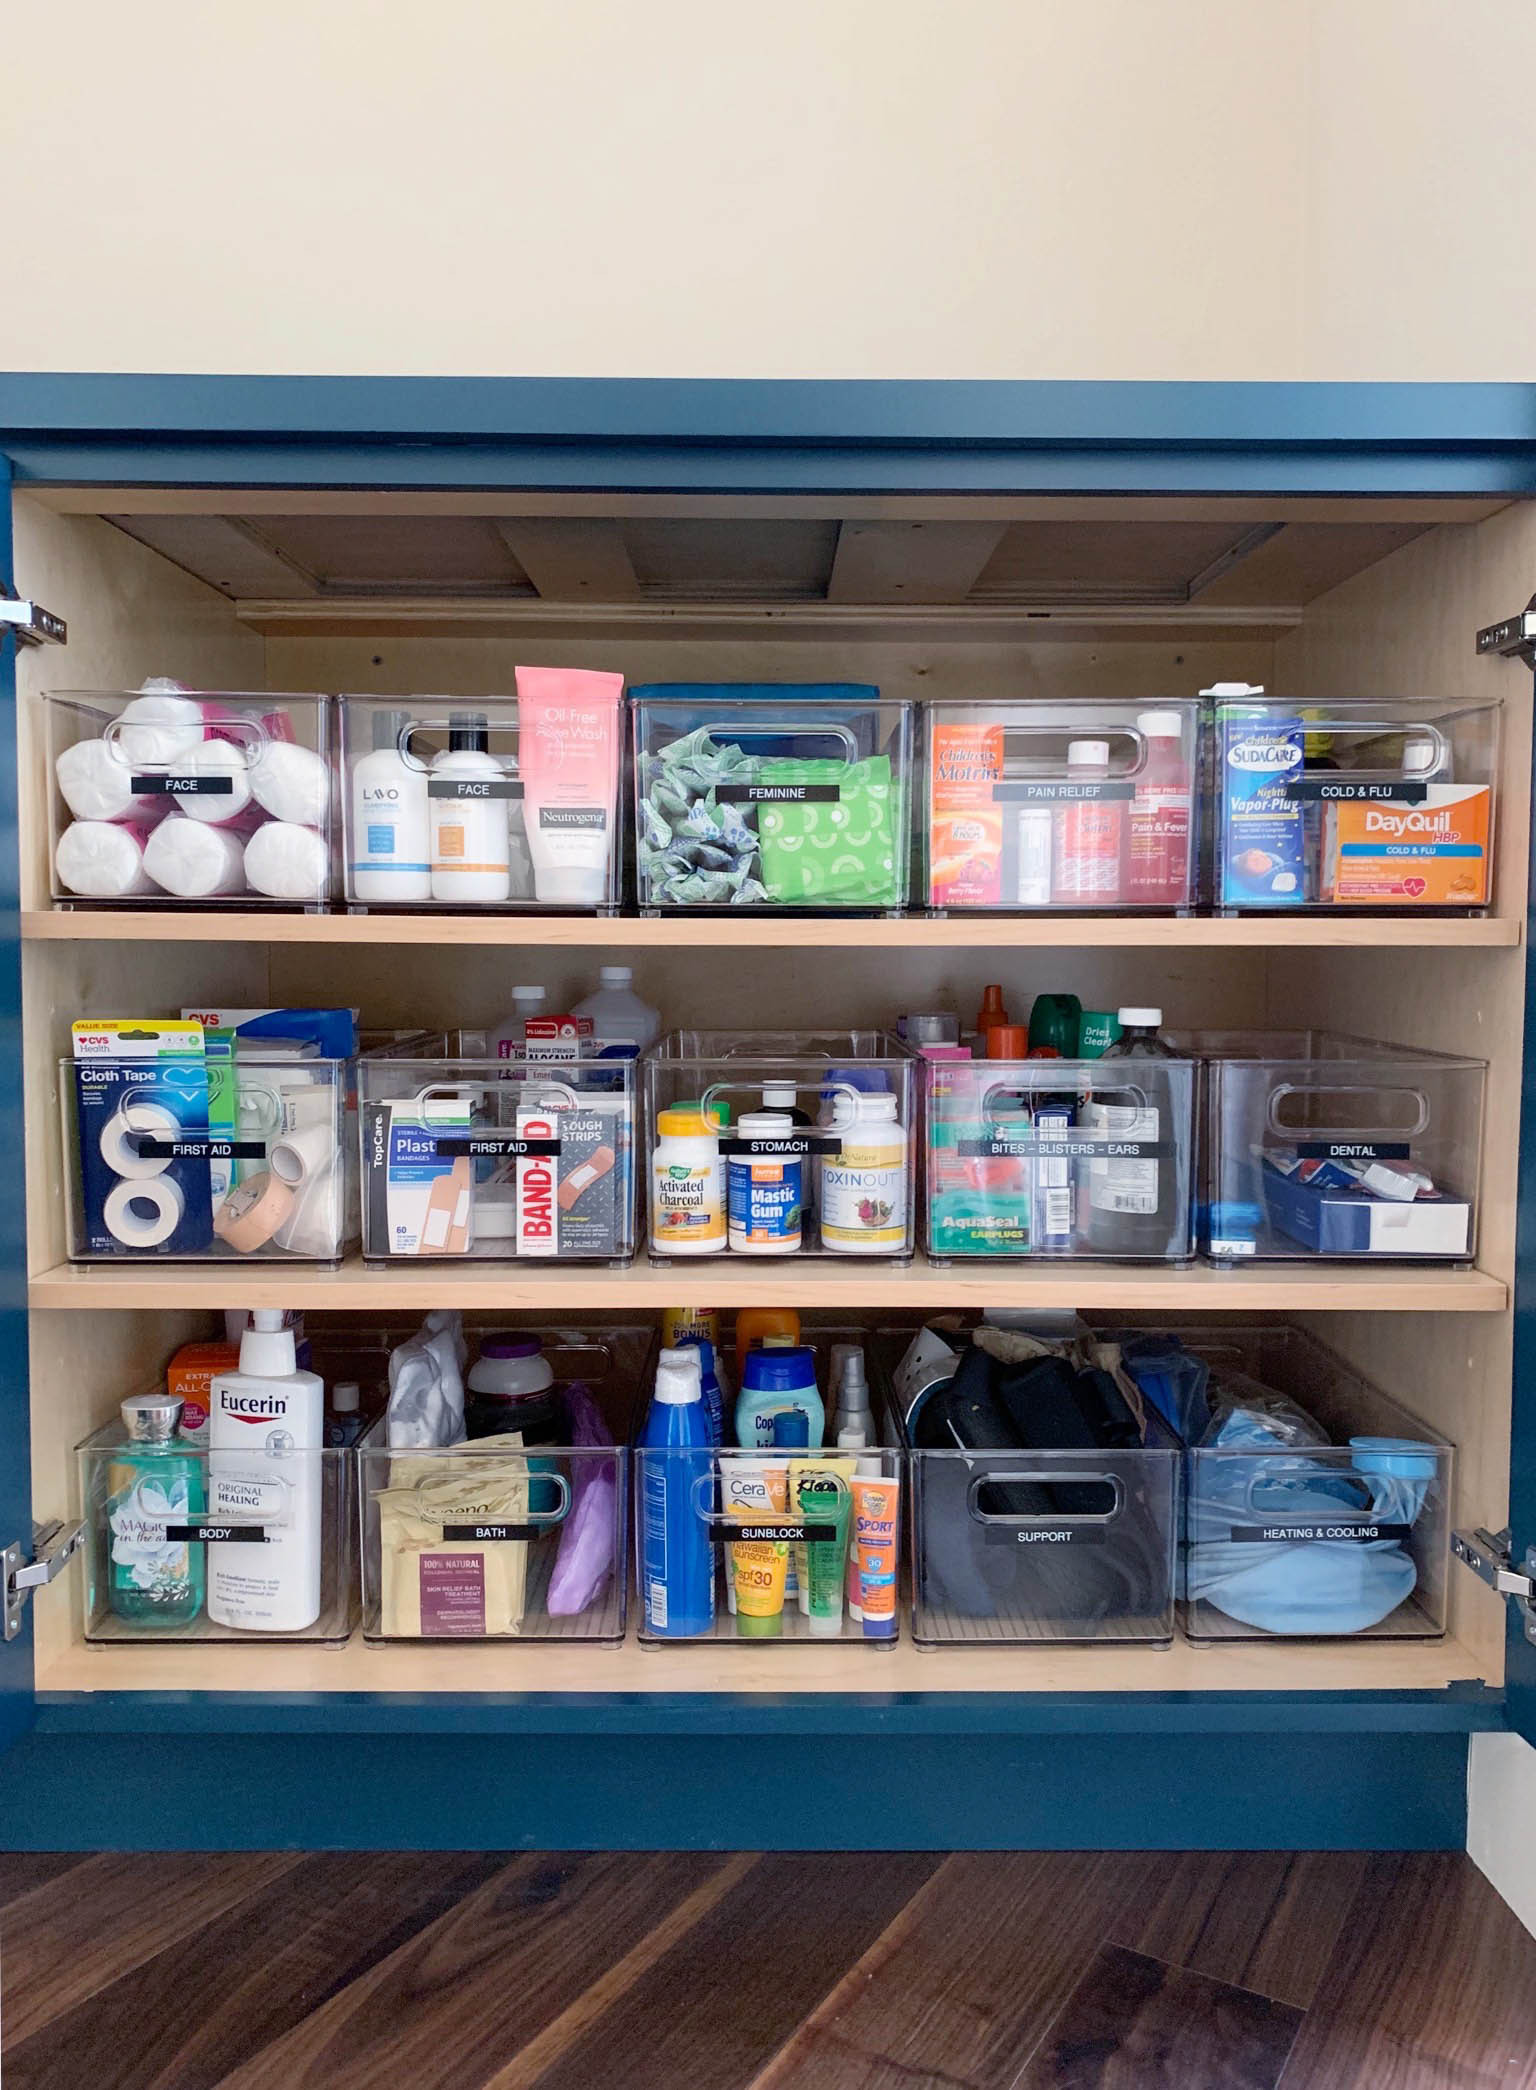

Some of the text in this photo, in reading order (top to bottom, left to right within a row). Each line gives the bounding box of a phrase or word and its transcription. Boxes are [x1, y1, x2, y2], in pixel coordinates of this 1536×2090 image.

[165, 780, 198, 791] FACE
[457, 784, 490, 796] FACE
[749, 788, 806, 799] FEMININE
[1027, 787, 1101, 798] PAIN RELIEF
[1321, 787, 1392, 798] COLD & FLU
[1231, 797, 1299, 813] Vapor-Plug
[543, 811, 605, 825] Neutrogena
[1132, 823, 1153, 832] Pain
[1154, 823, 1162, 832] &
[1365, 811, 1451, 837] DayQuil
[1433, 832, 1460, 843] HBP
[1386, 847, 1437, 855] COLD & FLU
[88, 1036, 110, 1045] CVS
[80, 1045, 110, 1053] Health
[81, 1070, 157, 1083] Cloth Tape
[562, 1131, 603, 1142] STRIPS
[173, 1145, 231, 1155] FIRST AID
[470, 1143, 528, 1153] FIRST AID
[751, 1142, 809, 1152] STOMACH
[991, 1143, 1026, 1154] BITES
[1039, 1144, 1095, 1154] BLISTERS
[1107, 1144, 1140, 1155] EARS
[1330, 1145, 1377, 1157] DENTAL
[659, 1178, 704, 1193] Activated
[659, 1192, 704, 1206] Charcoal
[751, 1187, 795, 1203] Mastic
[751, 1203, 784, 1218] Gum
[942, 1215, 1019, 1229] AquaSeal
[396, 1226, 407, 1234] 60
[970, 1230, 1025, 1239] EARPLUGS
[562, 1240, 573, 1248] 20
[673, 1328, 711, 1339] BONUS
[220, 1390, 287, 1414] Eucerin
[217, 1482, 263, 1497] ORIGINAL
[730, 1480, 785, 1497] CeraVe
[218, 1493, 260, 1506] HEALING
[857, 1516, 894, 1532] SPORT
[137, 1530, 151, 1543] the
[199, 1528, 232, 1539] BODY
[476, 1527, 506, 1538] BATH
[741, 1528, 804, 1539] SUNBLOCK
[1017, 1531, 1073, 1542] SUPPORT
[1263, 1527, 1379, 1539] HEATING & COOLING
[734, 1549, 781, 1565] sunscreen
[446, 1559, 480, 1569] NATURAL
[868, 1559, 881, 1568] 30
